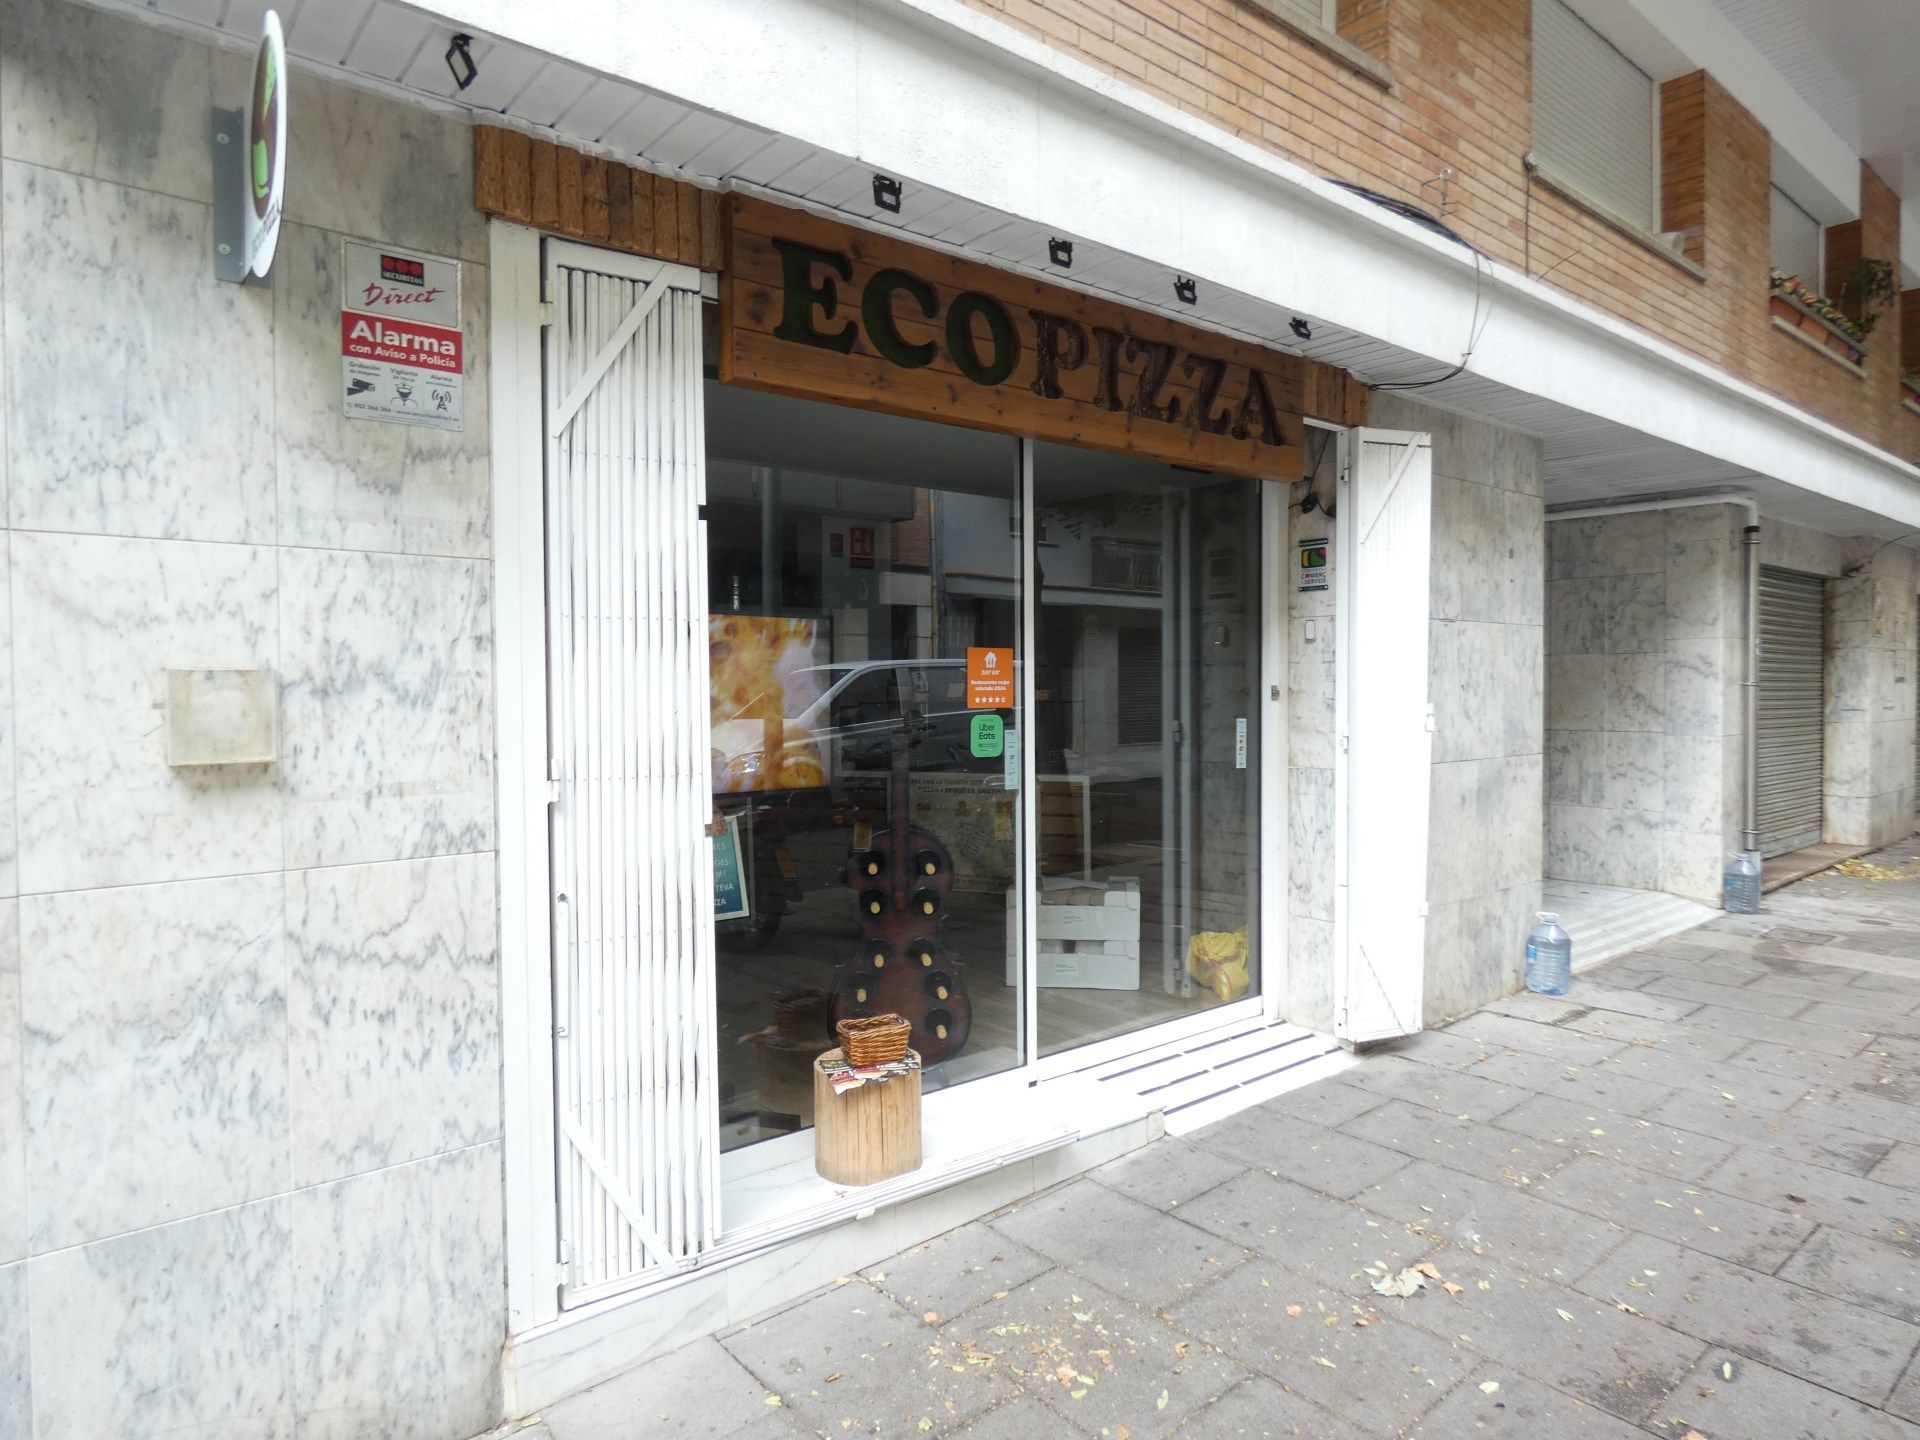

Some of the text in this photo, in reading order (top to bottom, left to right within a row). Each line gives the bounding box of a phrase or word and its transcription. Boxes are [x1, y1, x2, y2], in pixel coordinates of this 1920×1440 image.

[383, 271, 424, 285] SECURITAS
[363, 282, 446, 306] Direct
[350, 320, 455, 356] Alarma
[349, 344, 456, 368] con Aviso a Policía
[978, 723, 995, 732] Uber
[978, 732, 996, 740] Eats
